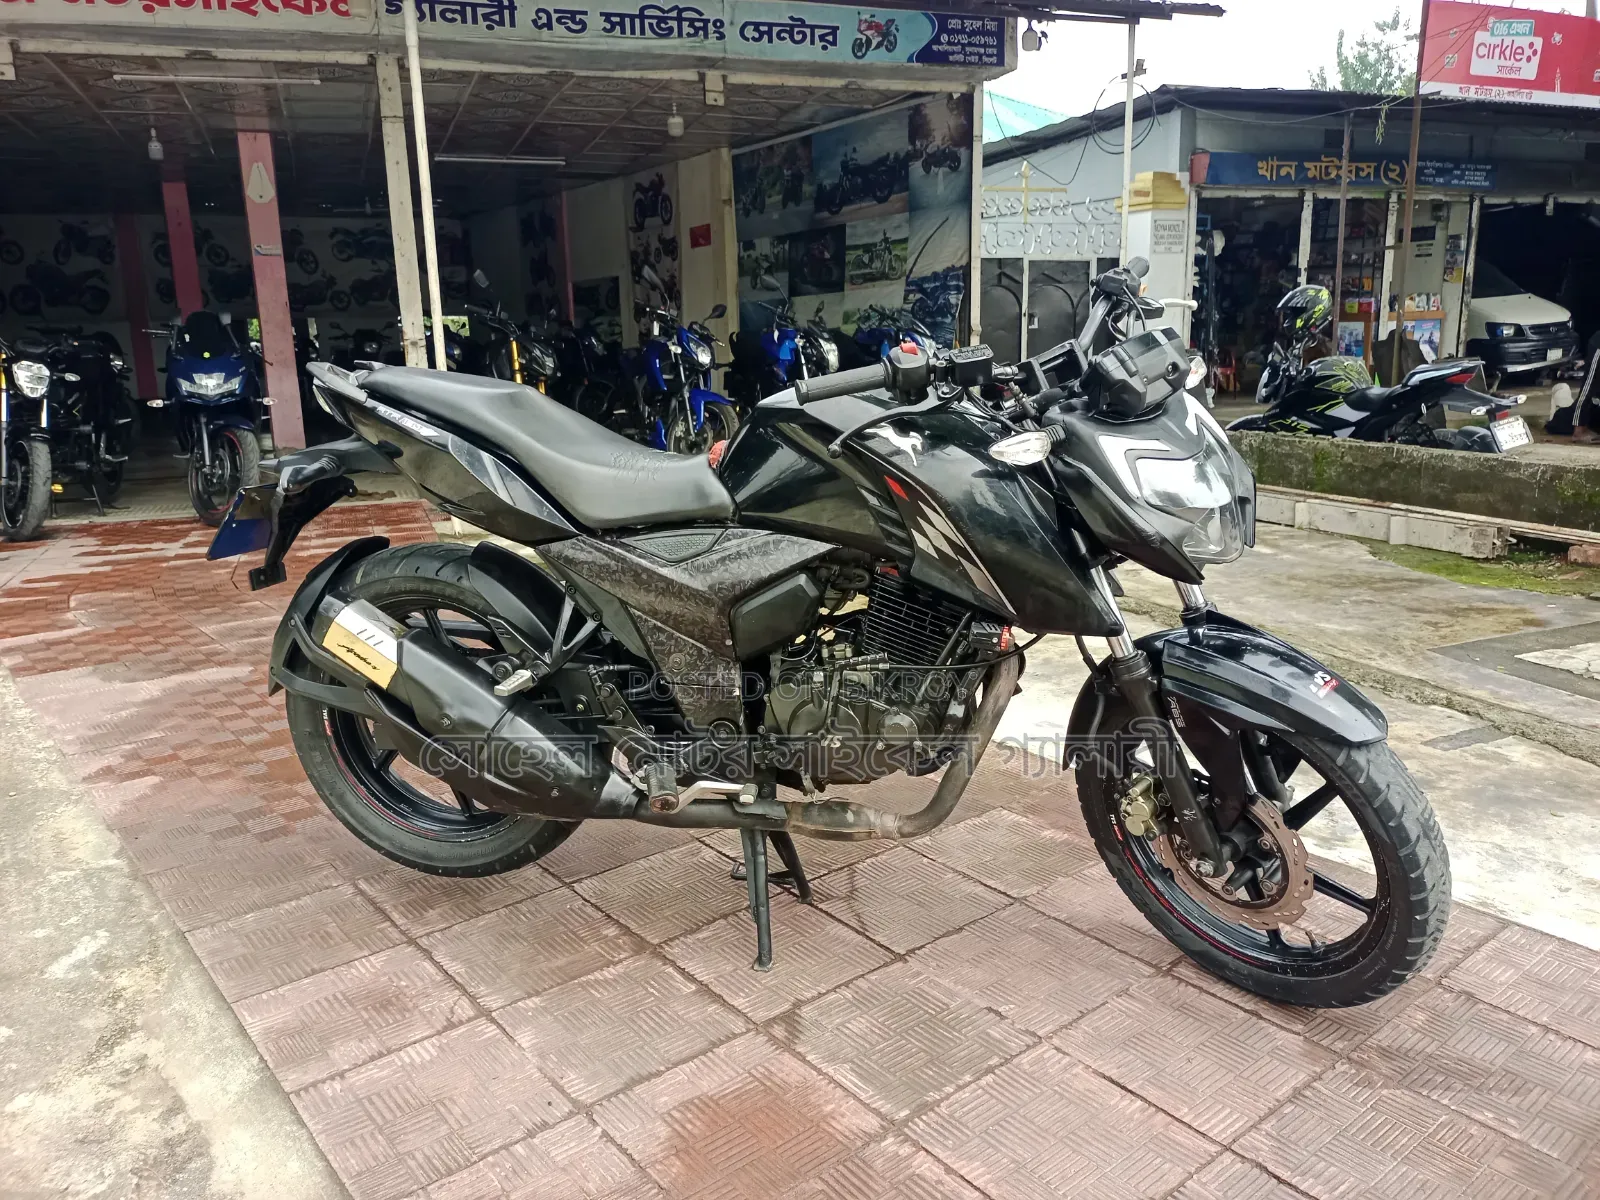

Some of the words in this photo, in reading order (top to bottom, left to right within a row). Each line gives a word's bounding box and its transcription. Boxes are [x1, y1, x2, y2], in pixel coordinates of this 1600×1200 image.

[531, 7, 588, 34] এন্ড
[600, 4, 726, 41] সার্ভিসিং
[739, 15, 840, 51] সেন্টার
[984, 17, 998, 31] মিয়া
[1493, 22, 1509, 36] 016
[1509, 22, 1531, 35] এখন
[1475, 38, 1525, 62] cirkle
[1496, 63, 1522, 76] সার্কেল
[1257, 155, 1299, 181] খান
[1380, 159, 1409, 185] (২)
